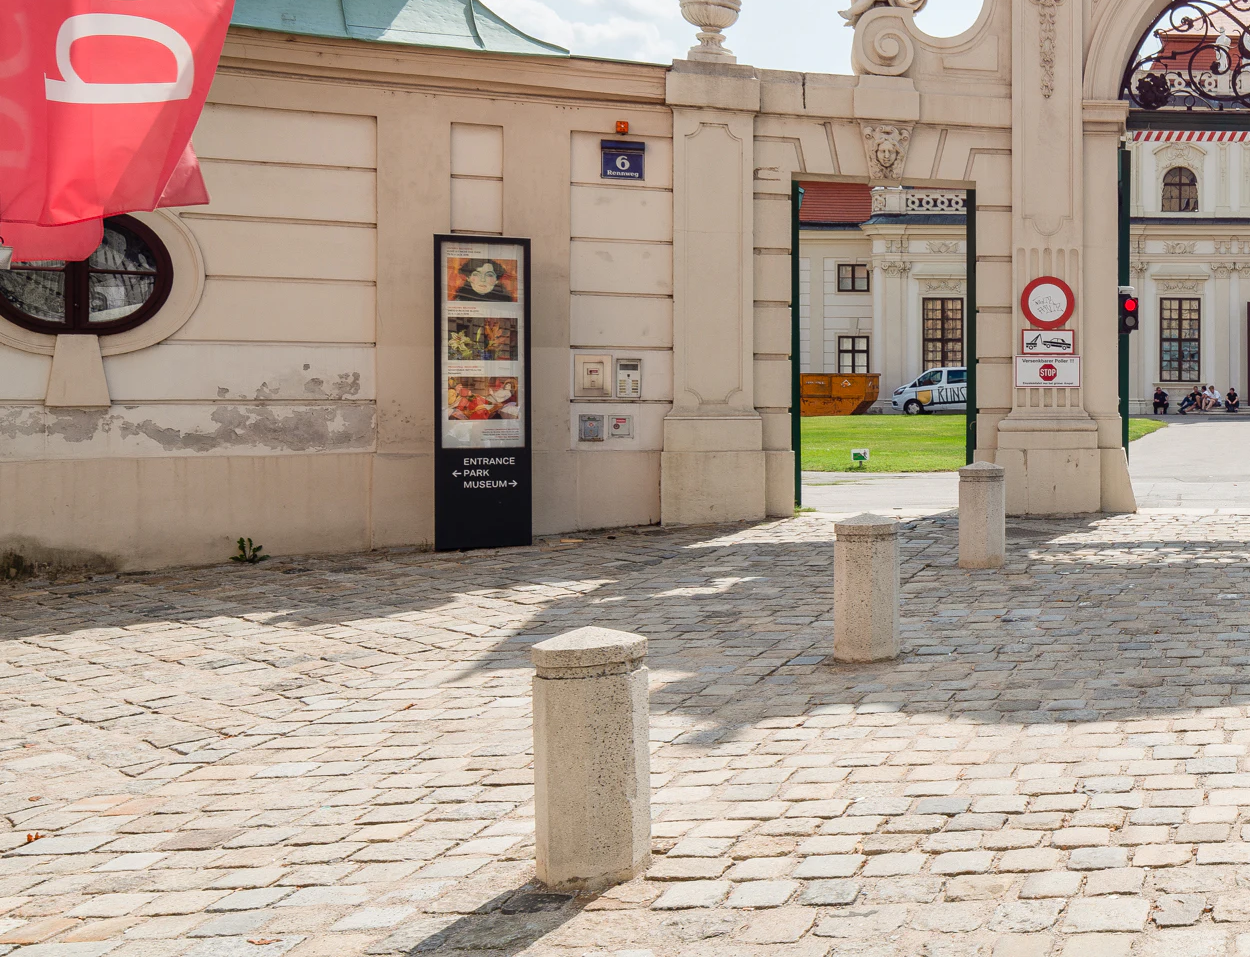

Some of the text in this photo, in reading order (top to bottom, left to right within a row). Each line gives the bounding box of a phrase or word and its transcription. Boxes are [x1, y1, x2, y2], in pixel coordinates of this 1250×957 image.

[616, 155, 630, 170] 6
[1040, 368, 1056, 377] STOP
[463, 457, 516, 466] ENTRANCE
[463, 469, 490, 477] PARK
[463, 480, 508, 488] MUSEUM
